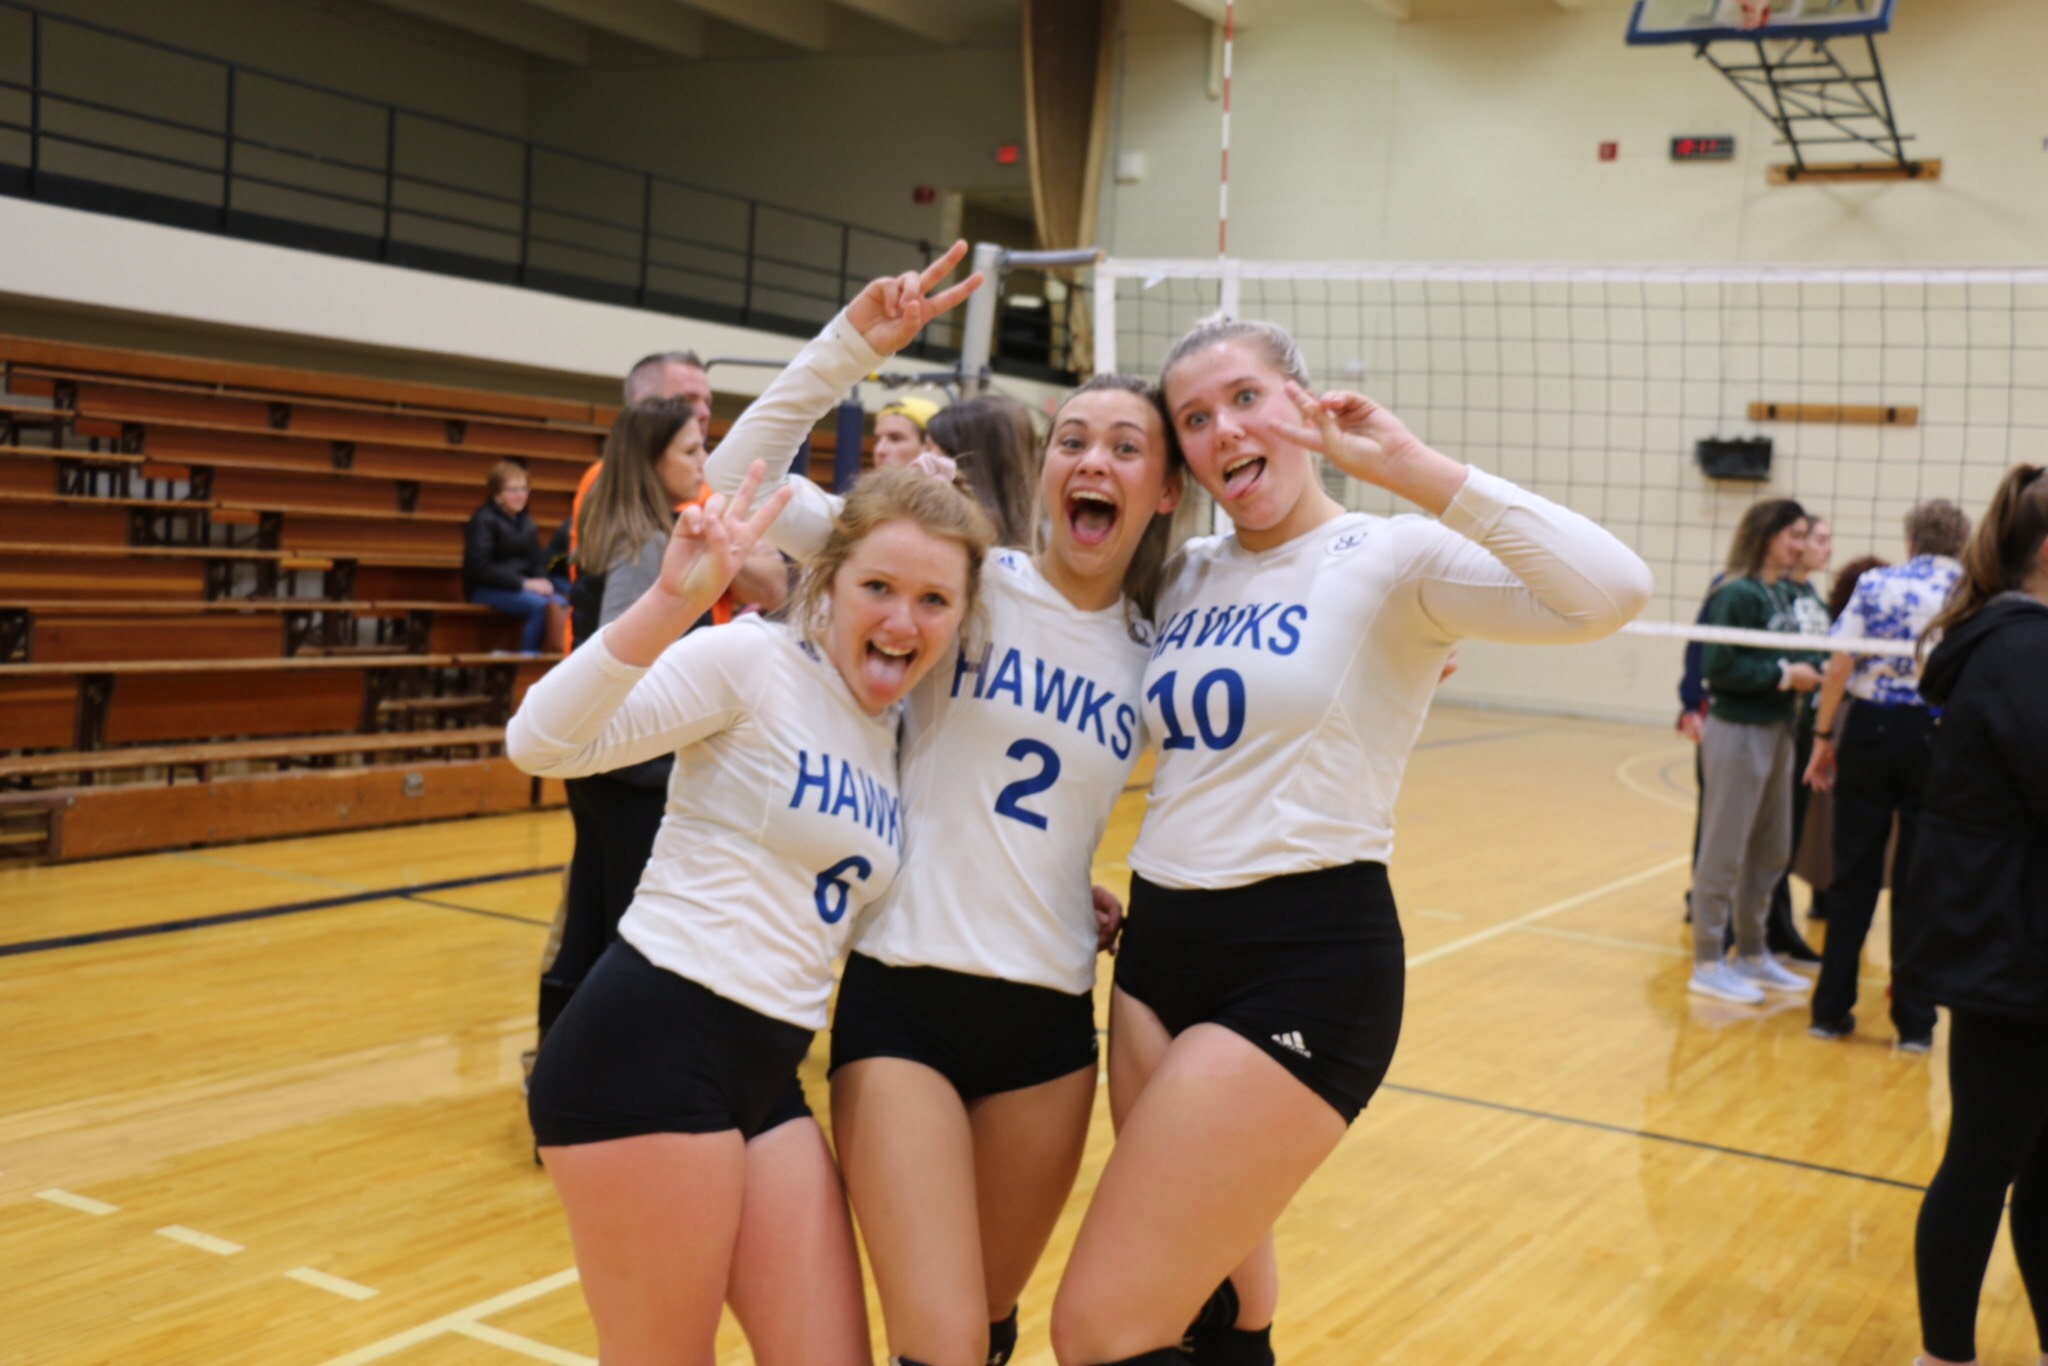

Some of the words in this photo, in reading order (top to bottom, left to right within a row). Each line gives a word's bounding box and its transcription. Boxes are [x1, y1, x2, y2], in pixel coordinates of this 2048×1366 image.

[1152, 602, 1308, 661] HAWKS
[950, 636, 1136, 761] HAWKS
[1147, 667, 1246, 751] 10
[789, 749, 904, 856] HAWK
[994, 738, 1061, 831] 2
[814, 855, 872, 925] 6
